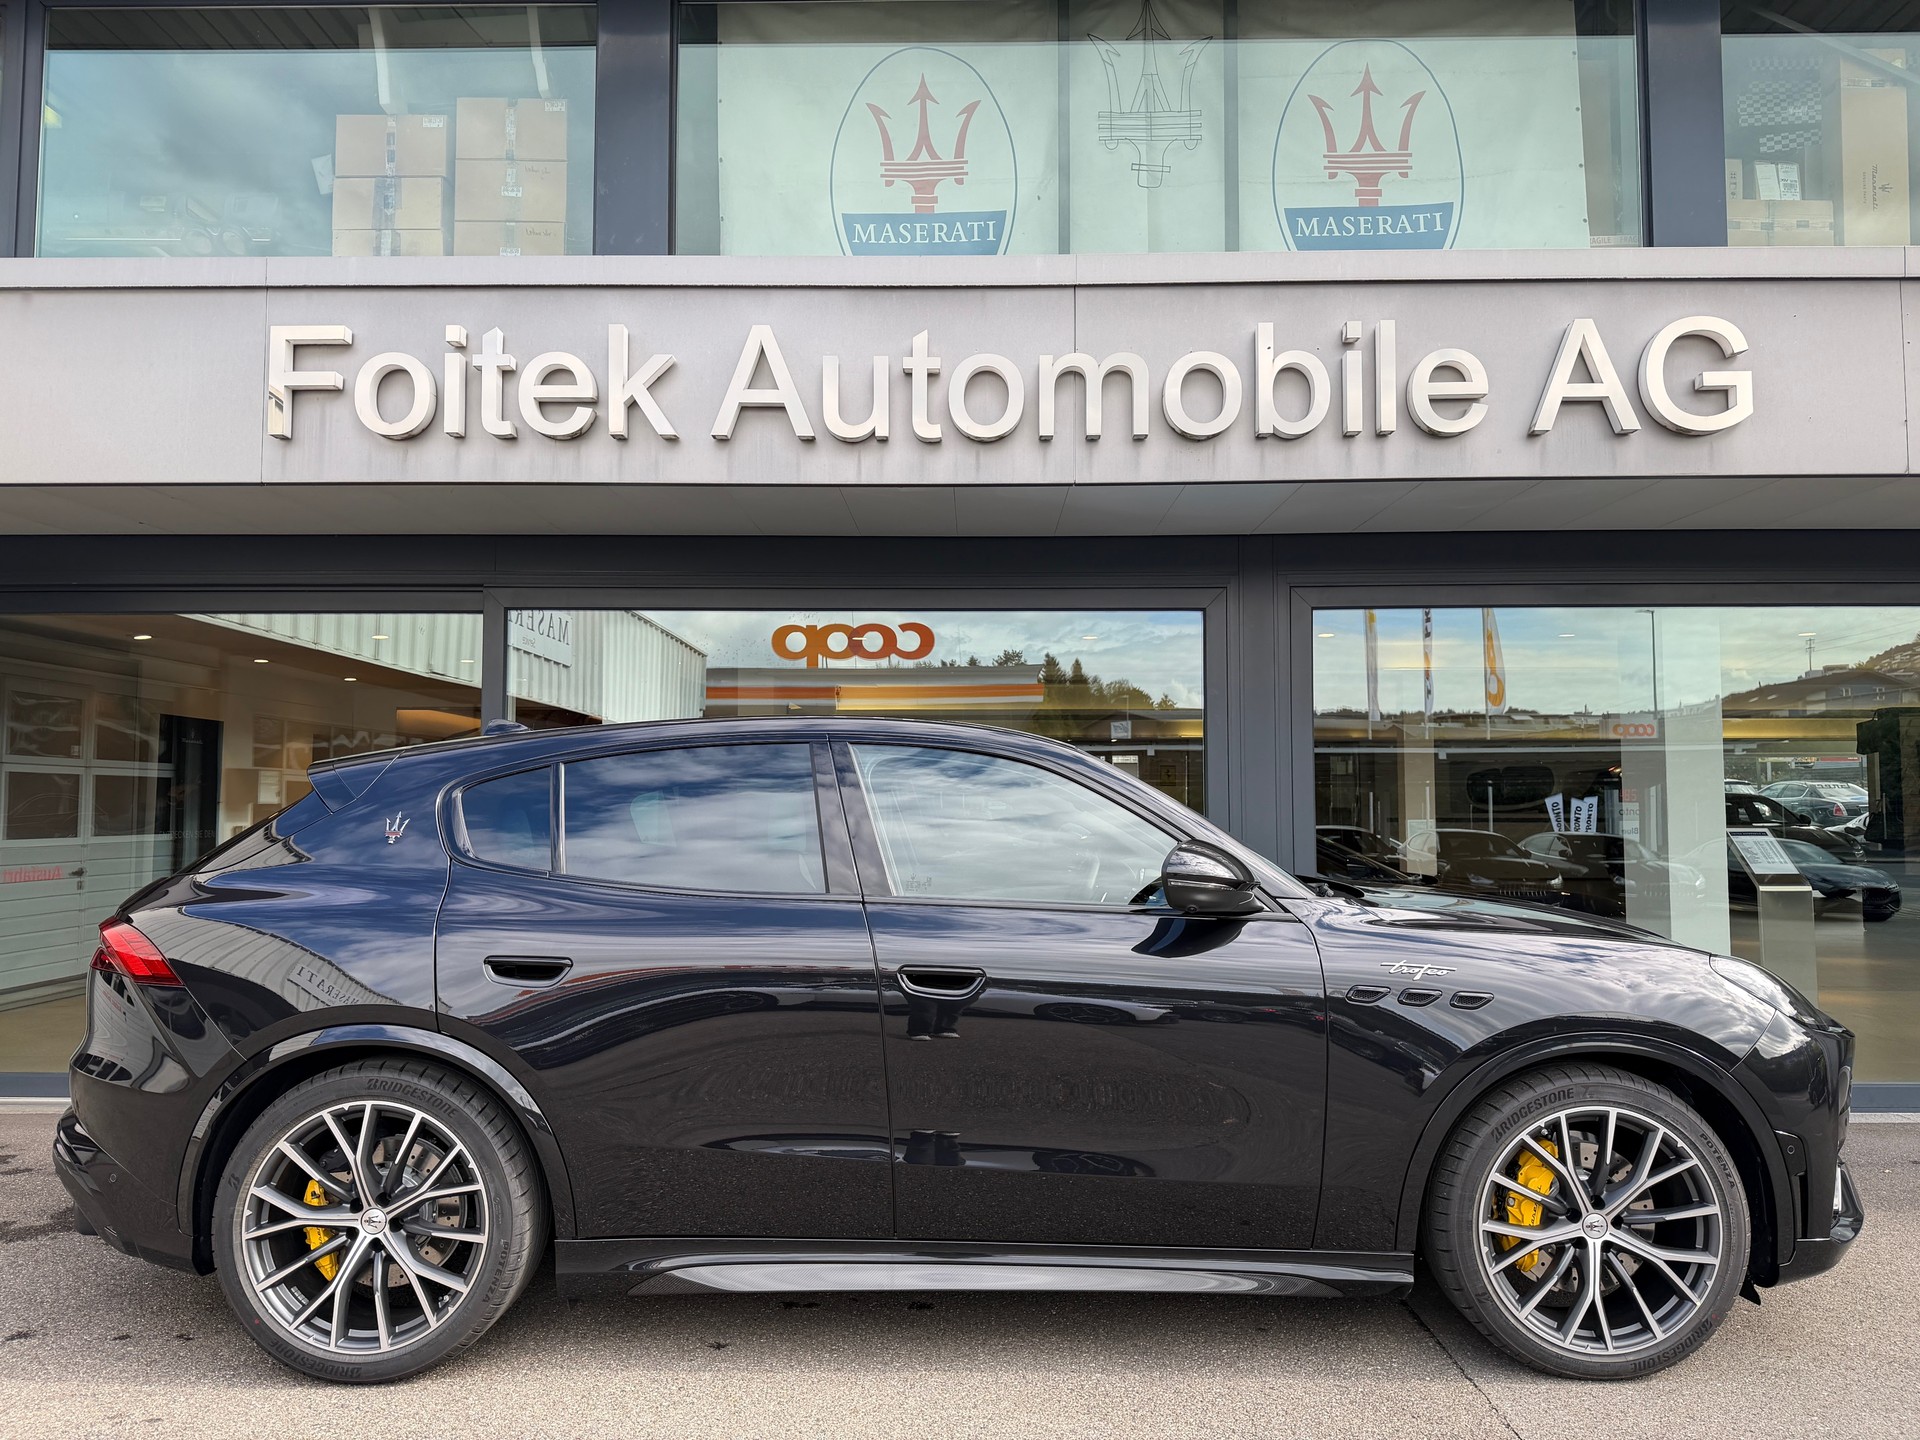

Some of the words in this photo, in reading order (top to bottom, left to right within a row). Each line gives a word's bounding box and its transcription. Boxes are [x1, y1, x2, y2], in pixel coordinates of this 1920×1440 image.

[852, 220, 997, 244] MASERATI
[1295, 212, 1444, 237] MASERATI
[267, 324, 679, 440] Foitek
[711, 320, 1489, 442] Automobile
[1529, 315, 1754, 437] AG
[1380, 960, 1457, 981] trofeo
[366, 1078, 458, 1118] BRIDGESTONE
[1491, 1087, 1574, 1143] BRIDGESTONE
[1700, 1133, 1736, 1190] POTENZA
[482, 1241, 510, 1303] POTENZA
